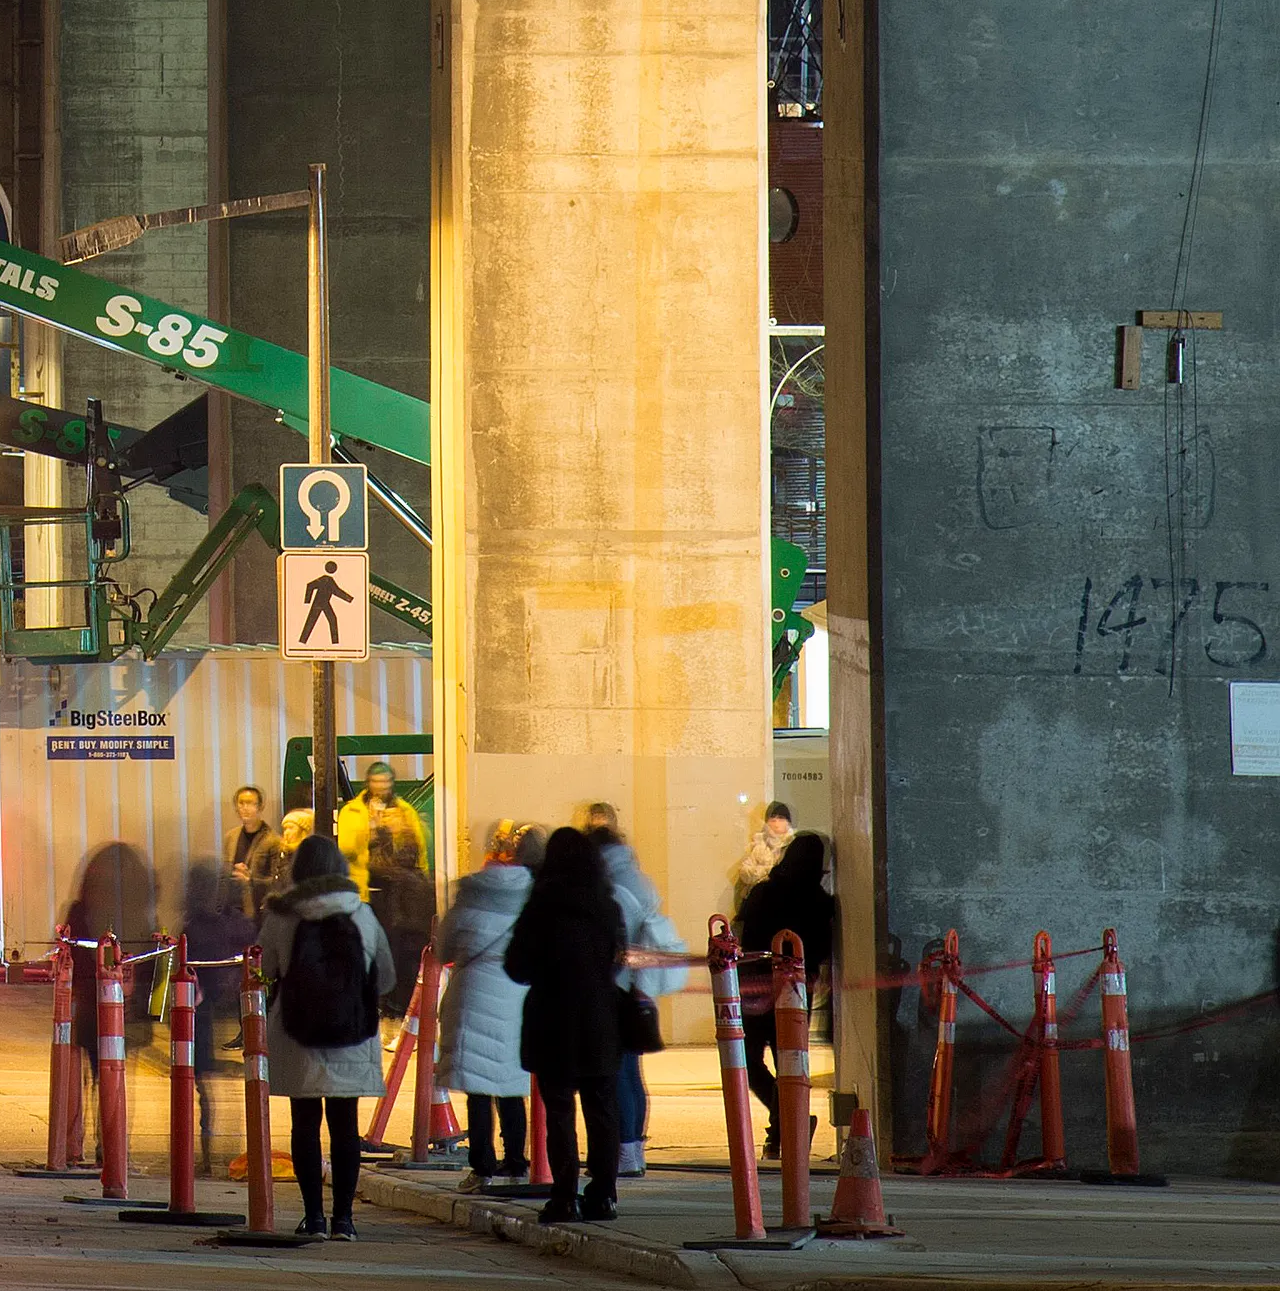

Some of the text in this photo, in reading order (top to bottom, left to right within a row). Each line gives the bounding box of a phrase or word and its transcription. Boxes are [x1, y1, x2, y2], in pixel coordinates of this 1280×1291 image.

[95, 295, 229, 368] S-85
[11, 409, 121, 454] S-8
[1073, 574, 1269, 674] 1475
[71, 710, 167, 730] BigSteelBox
